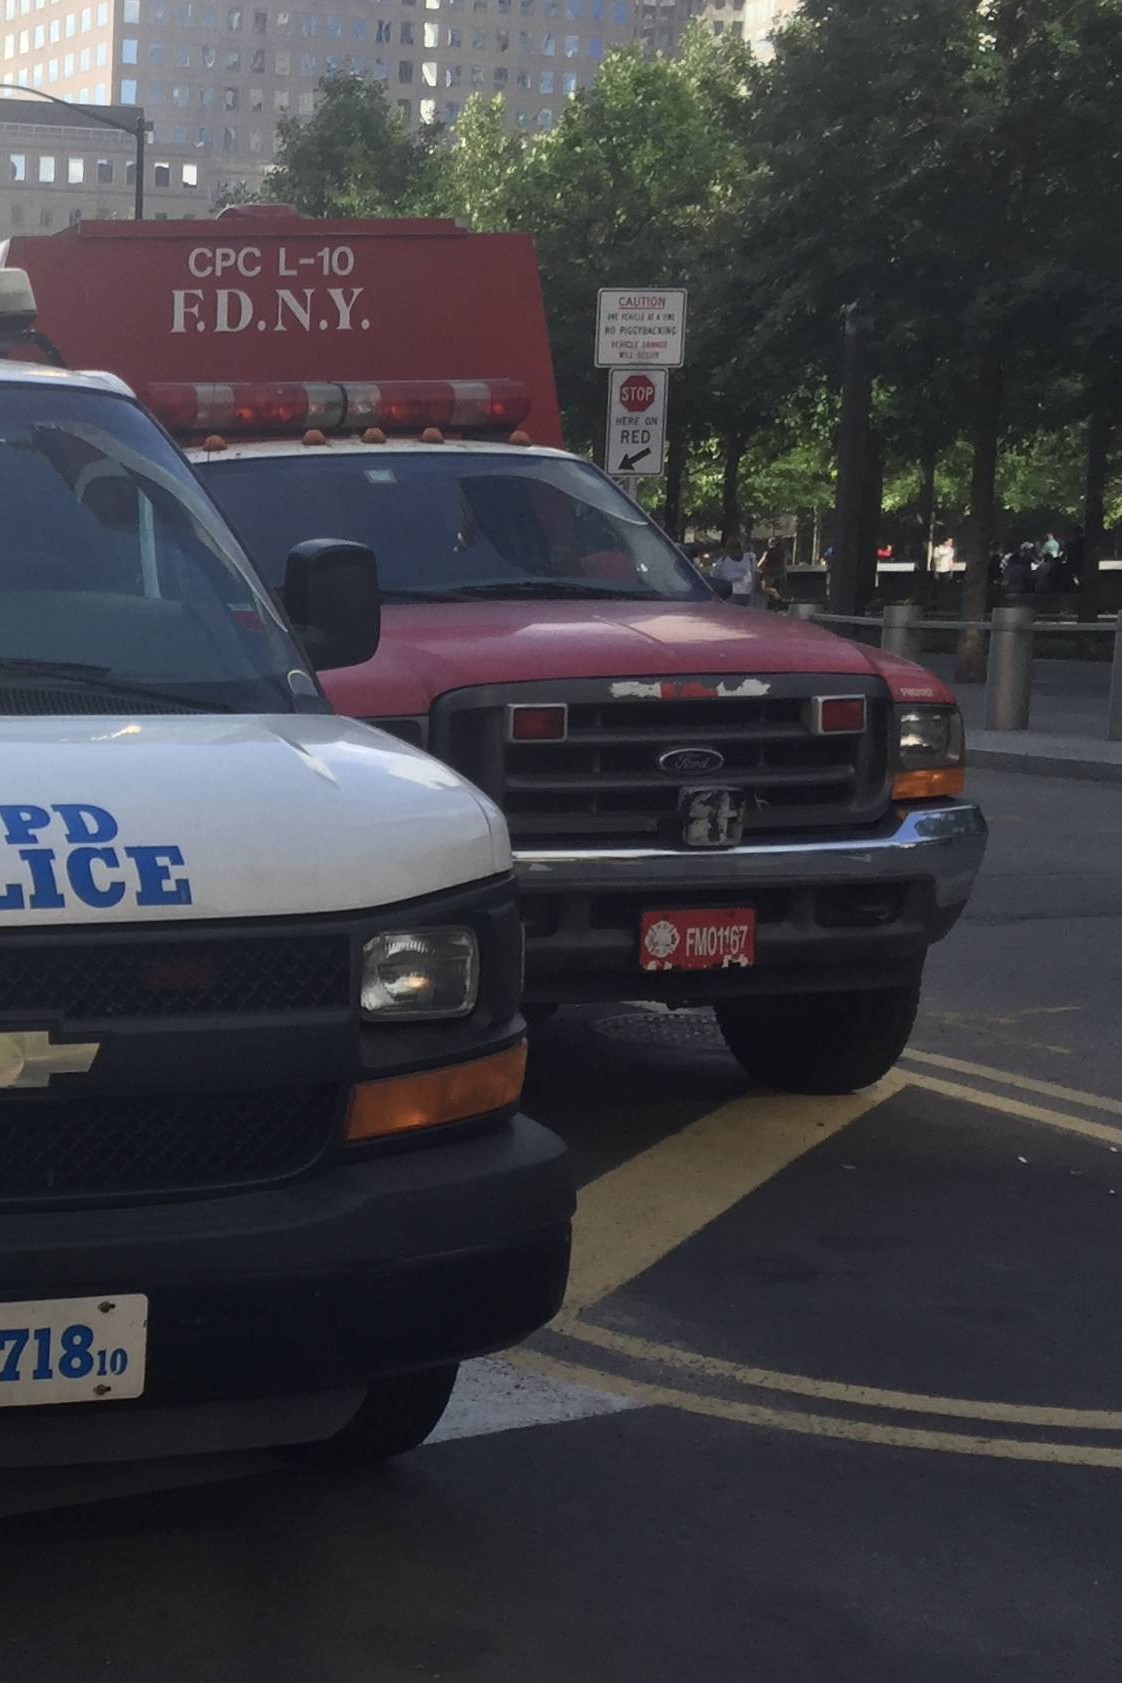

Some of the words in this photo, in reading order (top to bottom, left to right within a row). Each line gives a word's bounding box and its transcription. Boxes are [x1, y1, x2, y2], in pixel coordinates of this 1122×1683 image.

[188, 247, 262, 278] CPC
[278, 246, 355, 276] L-10
[170, 287, 371, 333] F.D.N.Y.
[618, 296, 666, 310] CAUTION
[604, 326, 616, 335] NO
[619, 326, 677, 335] PIGGYBACKING
[610, 340, 639, 349] VEHICLE
[621, 386, 654, 401] STOP
[615, 417, 640, 426] HERE
[644, 417, 658, 426] ON
[620, 429, 651, 444] RED
[96, 1347, 128, 1377] 10
